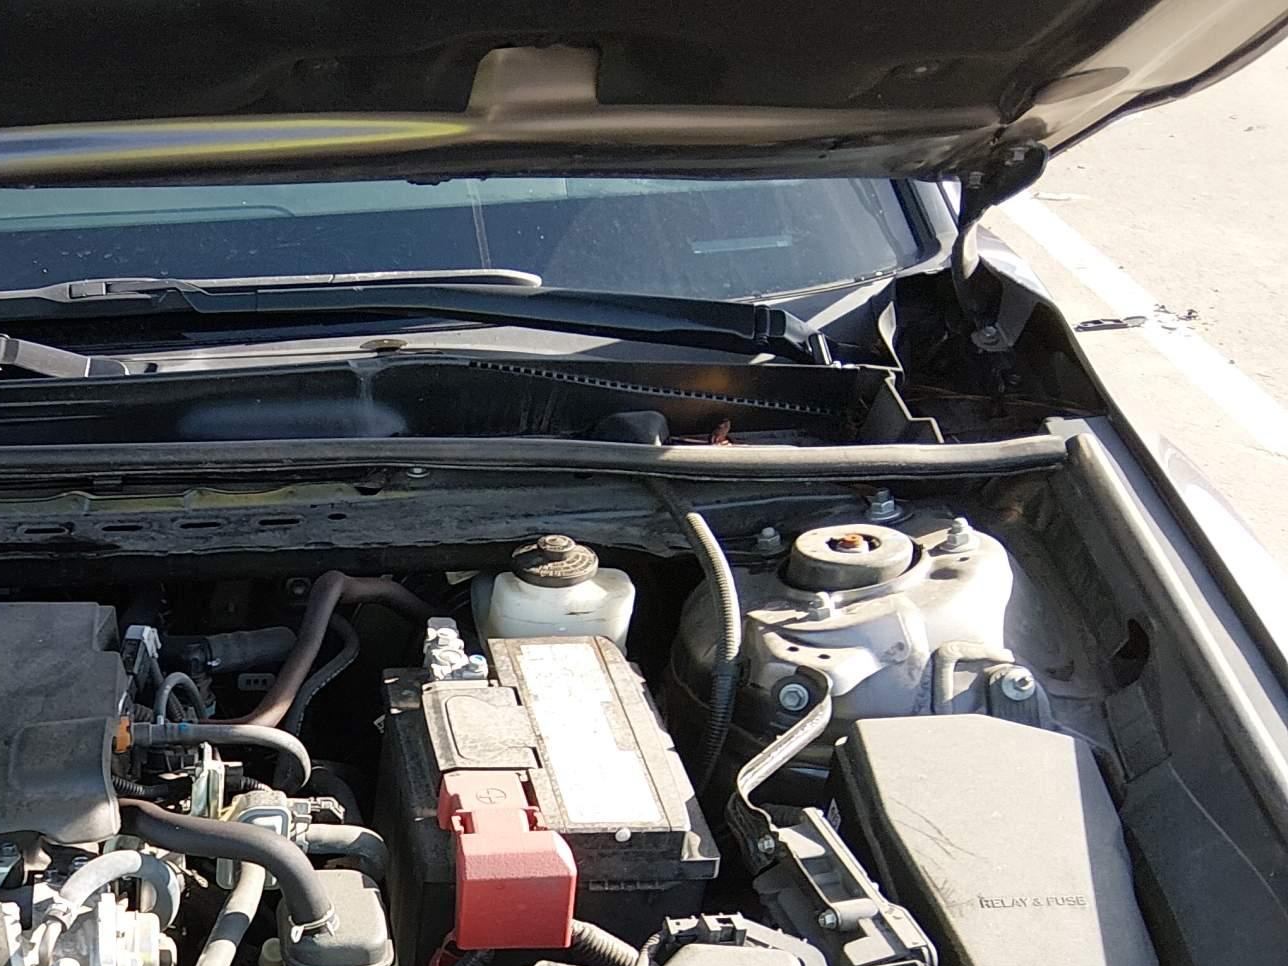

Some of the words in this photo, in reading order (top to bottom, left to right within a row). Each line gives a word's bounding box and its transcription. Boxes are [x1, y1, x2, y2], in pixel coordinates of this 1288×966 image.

[979, 896, 1028, 909] RELAY
[1032, 897, 1043, 907] &
[1047, 896, 1086, 907] FUSE
